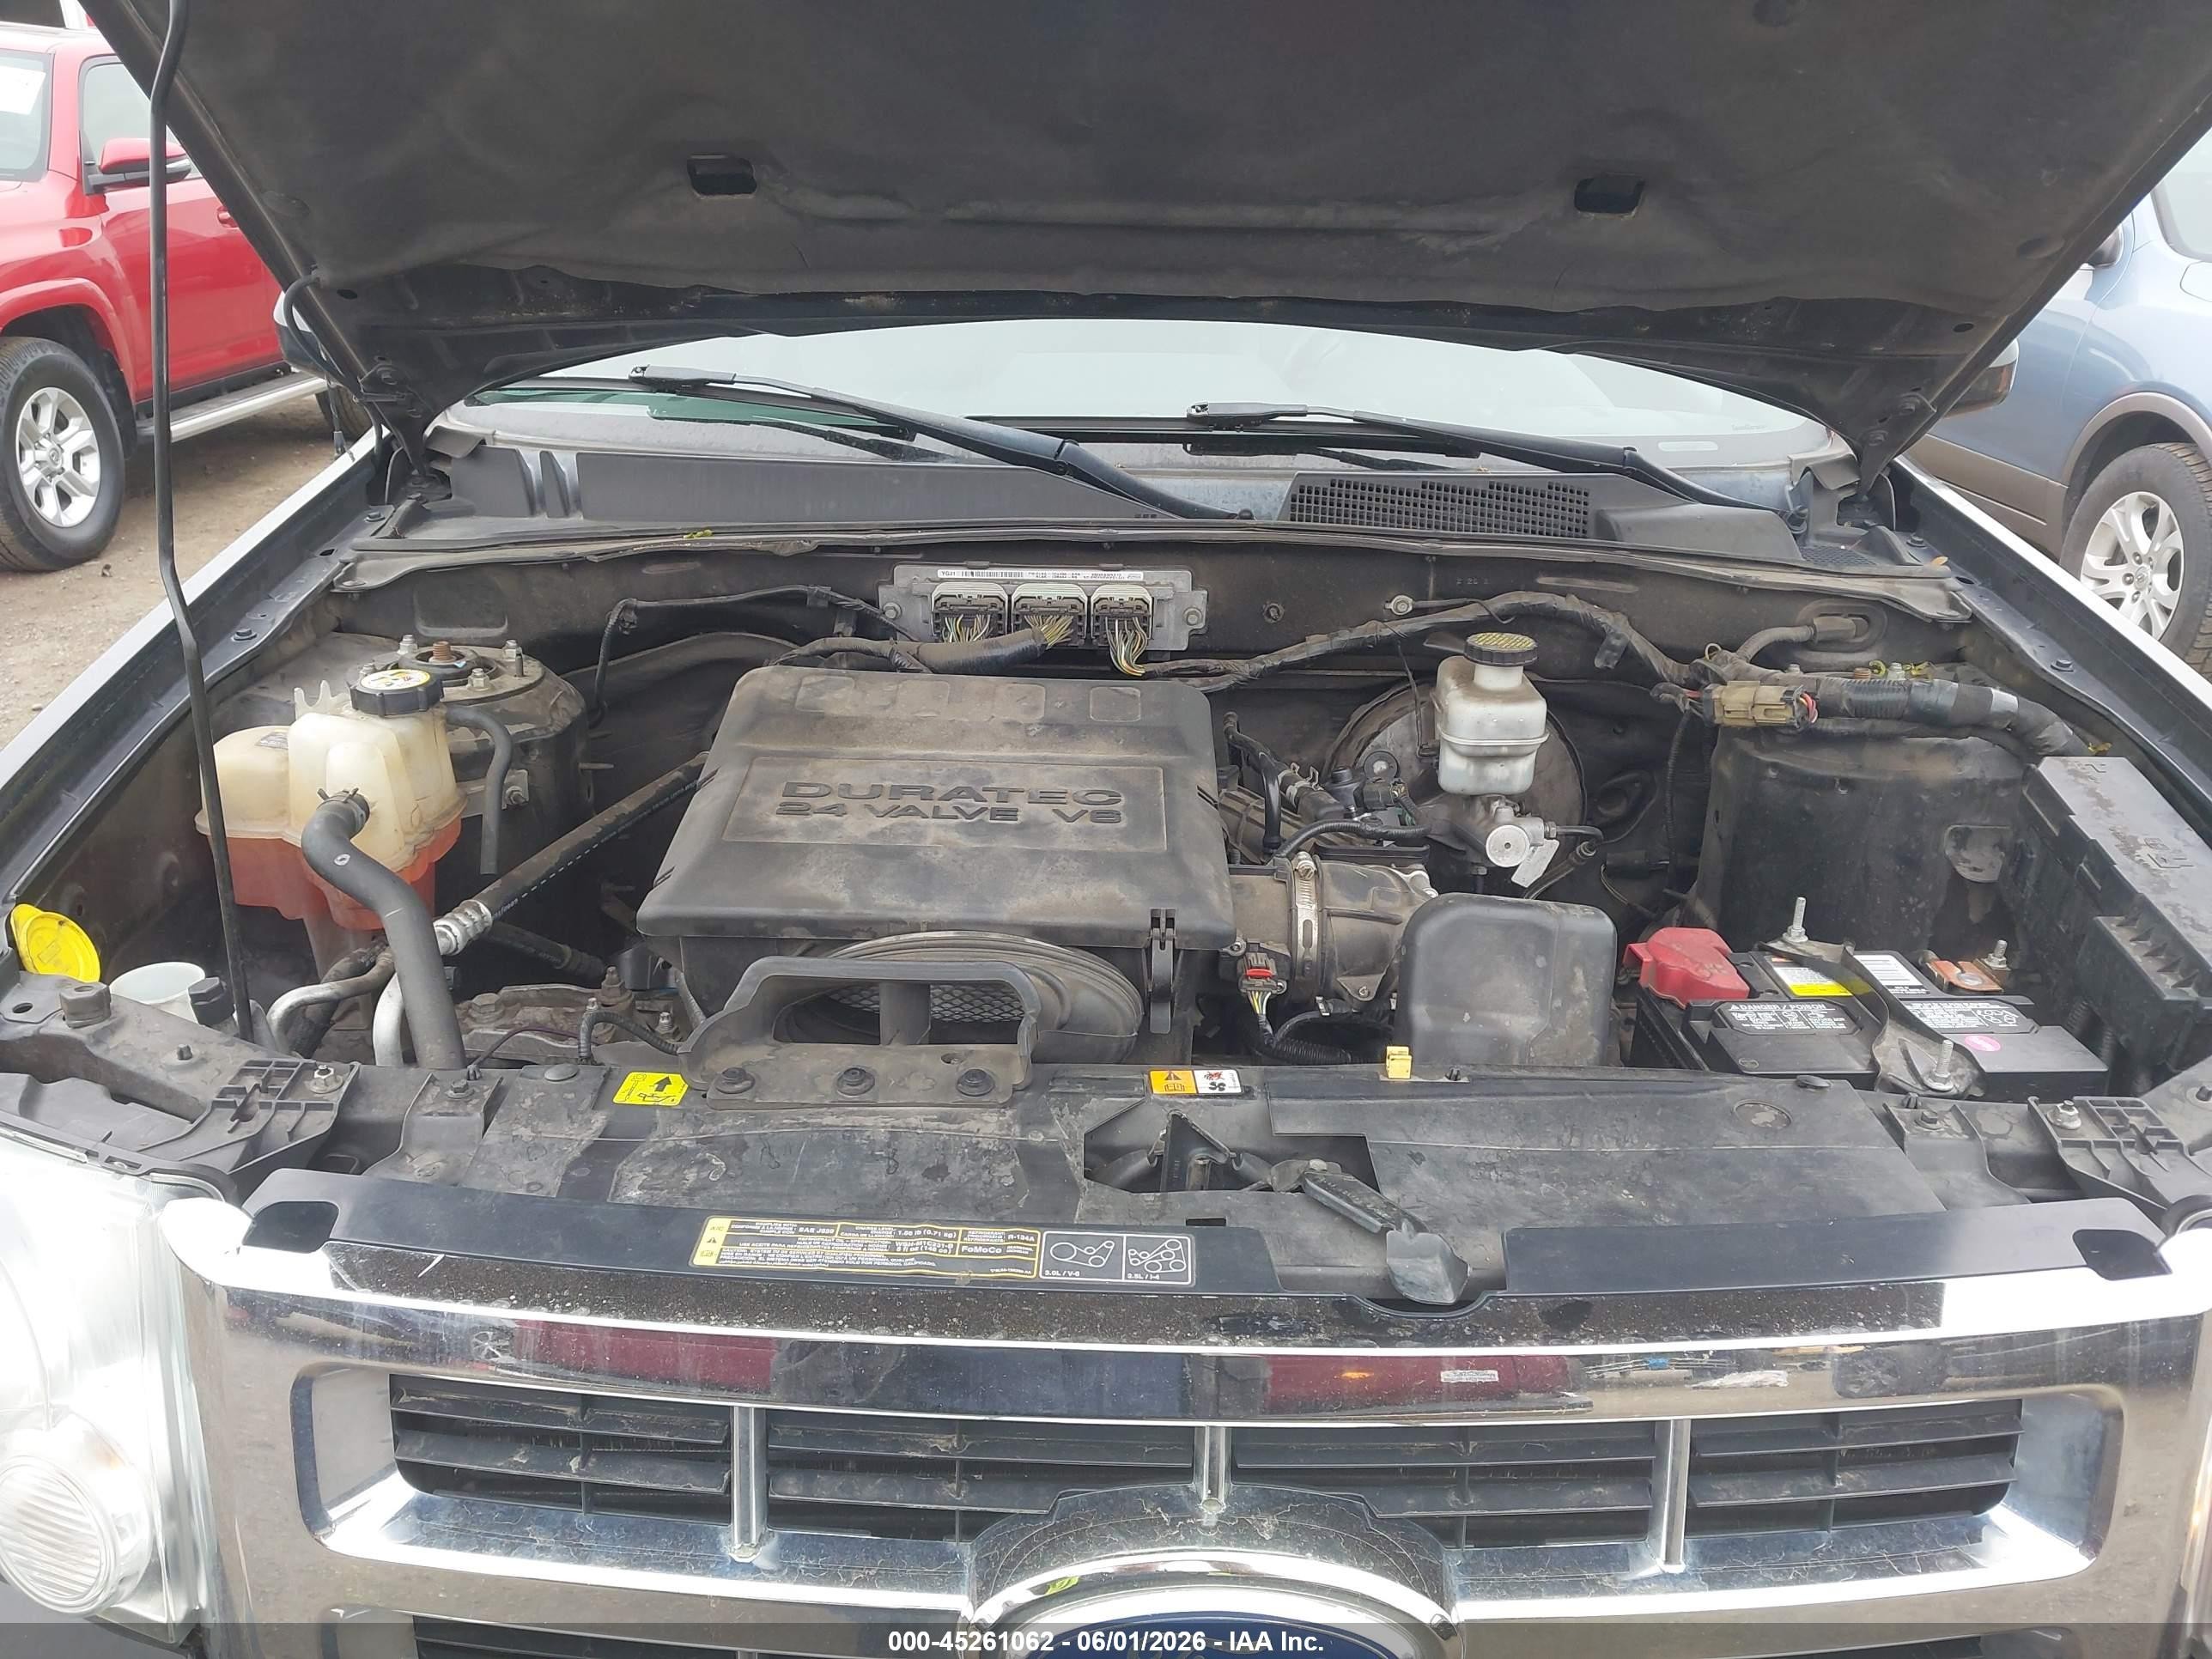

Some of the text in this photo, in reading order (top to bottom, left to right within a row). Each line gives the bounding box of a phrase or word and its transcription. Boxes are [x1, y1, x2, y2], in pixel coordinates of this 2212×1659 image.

[781, 782, 1122, 806] DURATEC
[775, 801, 1122, 824] 24 VALVE V6
[1007, 1233, 1035, 1242] R-134A
[961, 1245, 1003, 1254] FoMoCo
